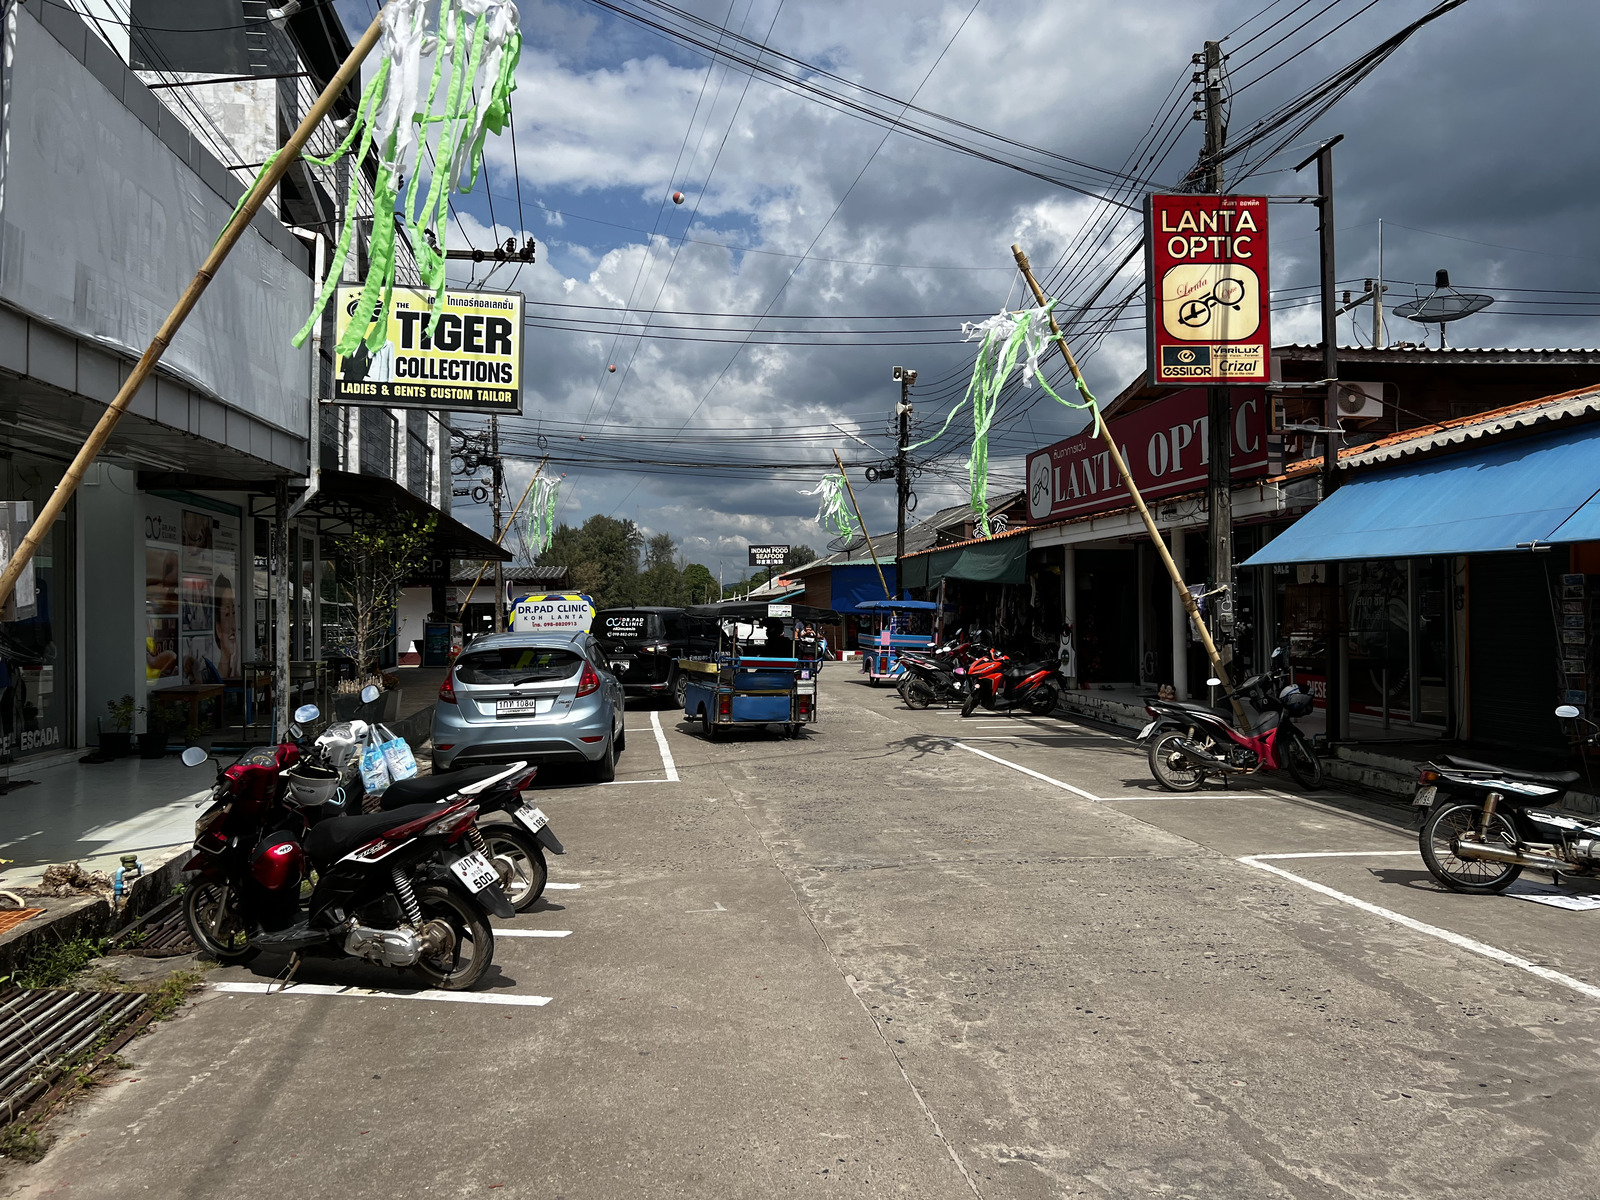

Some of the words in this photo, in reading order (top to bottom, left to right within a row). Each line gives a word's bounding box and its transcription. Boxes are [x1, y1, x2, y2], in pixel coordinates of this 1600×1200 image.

[1161, 209, 1258, 233] LANTA
[1167, 235, 1253, 259] OPTIC
[395, 310, 513, 356] TIGER
[395, 356, 513, 384] COLLECTIONS
[1219, 360, 1257, 371] Crizal
[341, 382, 377, 395] LADIES
[381, 384, 390, 396] &
[394, 385, 426, 398] GENTS
[430, 387, 473, 400] CUSTOM
[477, 389, 512, 403] TAILOR
[1147, 398, 1260, 477] OPTC
[518, 605, 554, 614] DR.PAD
[557, 604, 588, 613] CLINIC
[20, 725, 60, 751] ESCADA
[472, 871, 494, 890] 500
